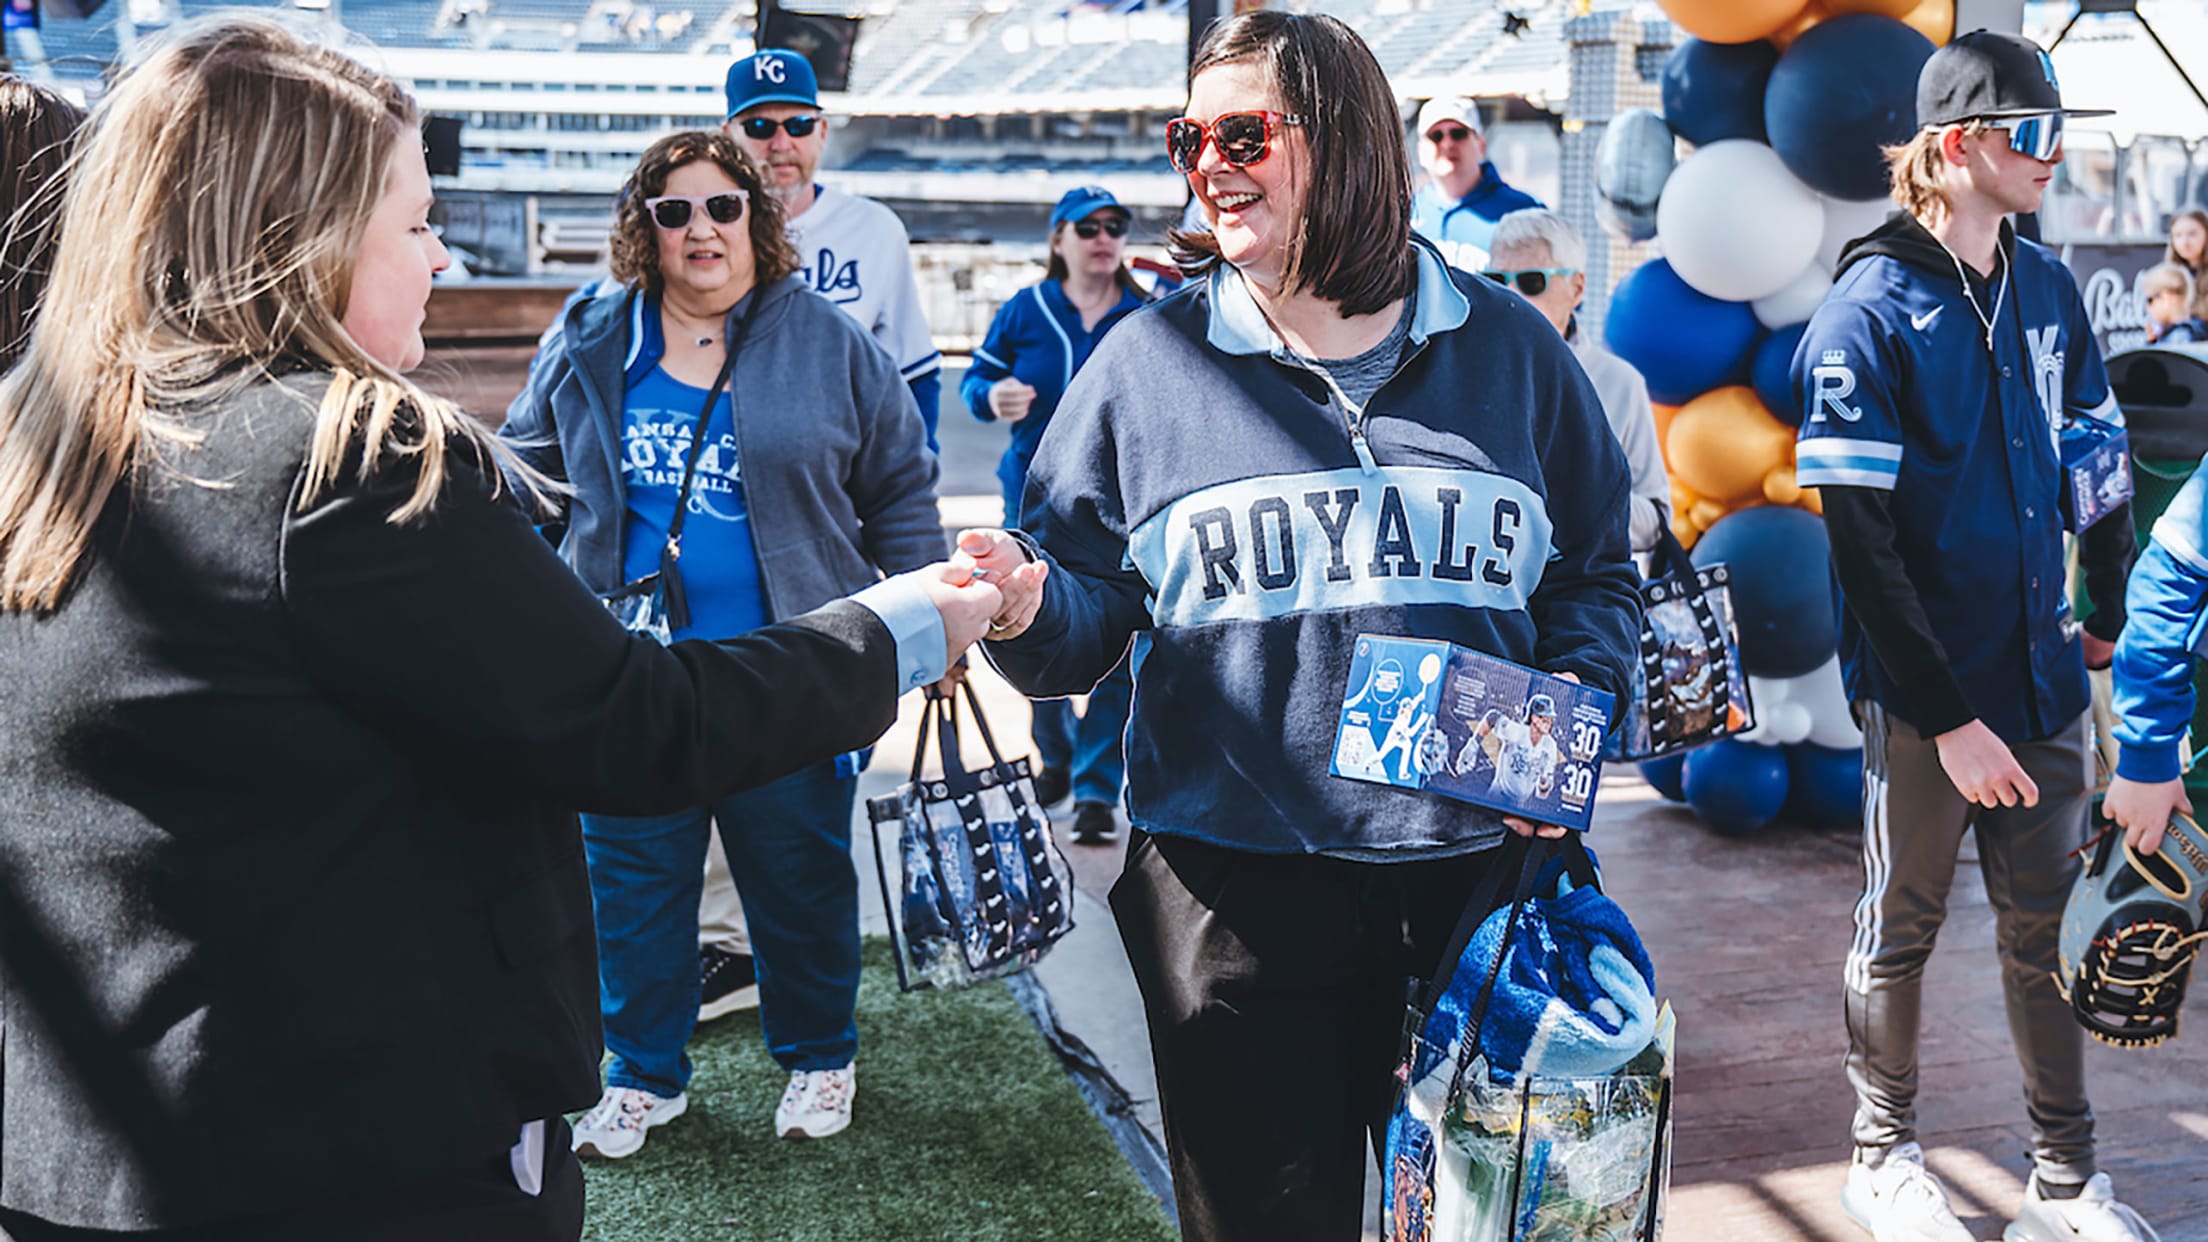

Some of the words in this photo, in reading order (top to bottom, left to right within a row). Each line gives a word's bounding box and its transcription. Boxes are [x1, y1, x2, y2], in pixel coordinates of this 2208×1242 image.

[754, 55, 786, 84] KC
[621, 422, 709, 442] ANSA
[621, 438, 741, 482] OYA
[1189, 485, 1522, 601] ROYALS
[1570, 721, 1602, 759] 30
[1561, 763, 1593, 800] 30
